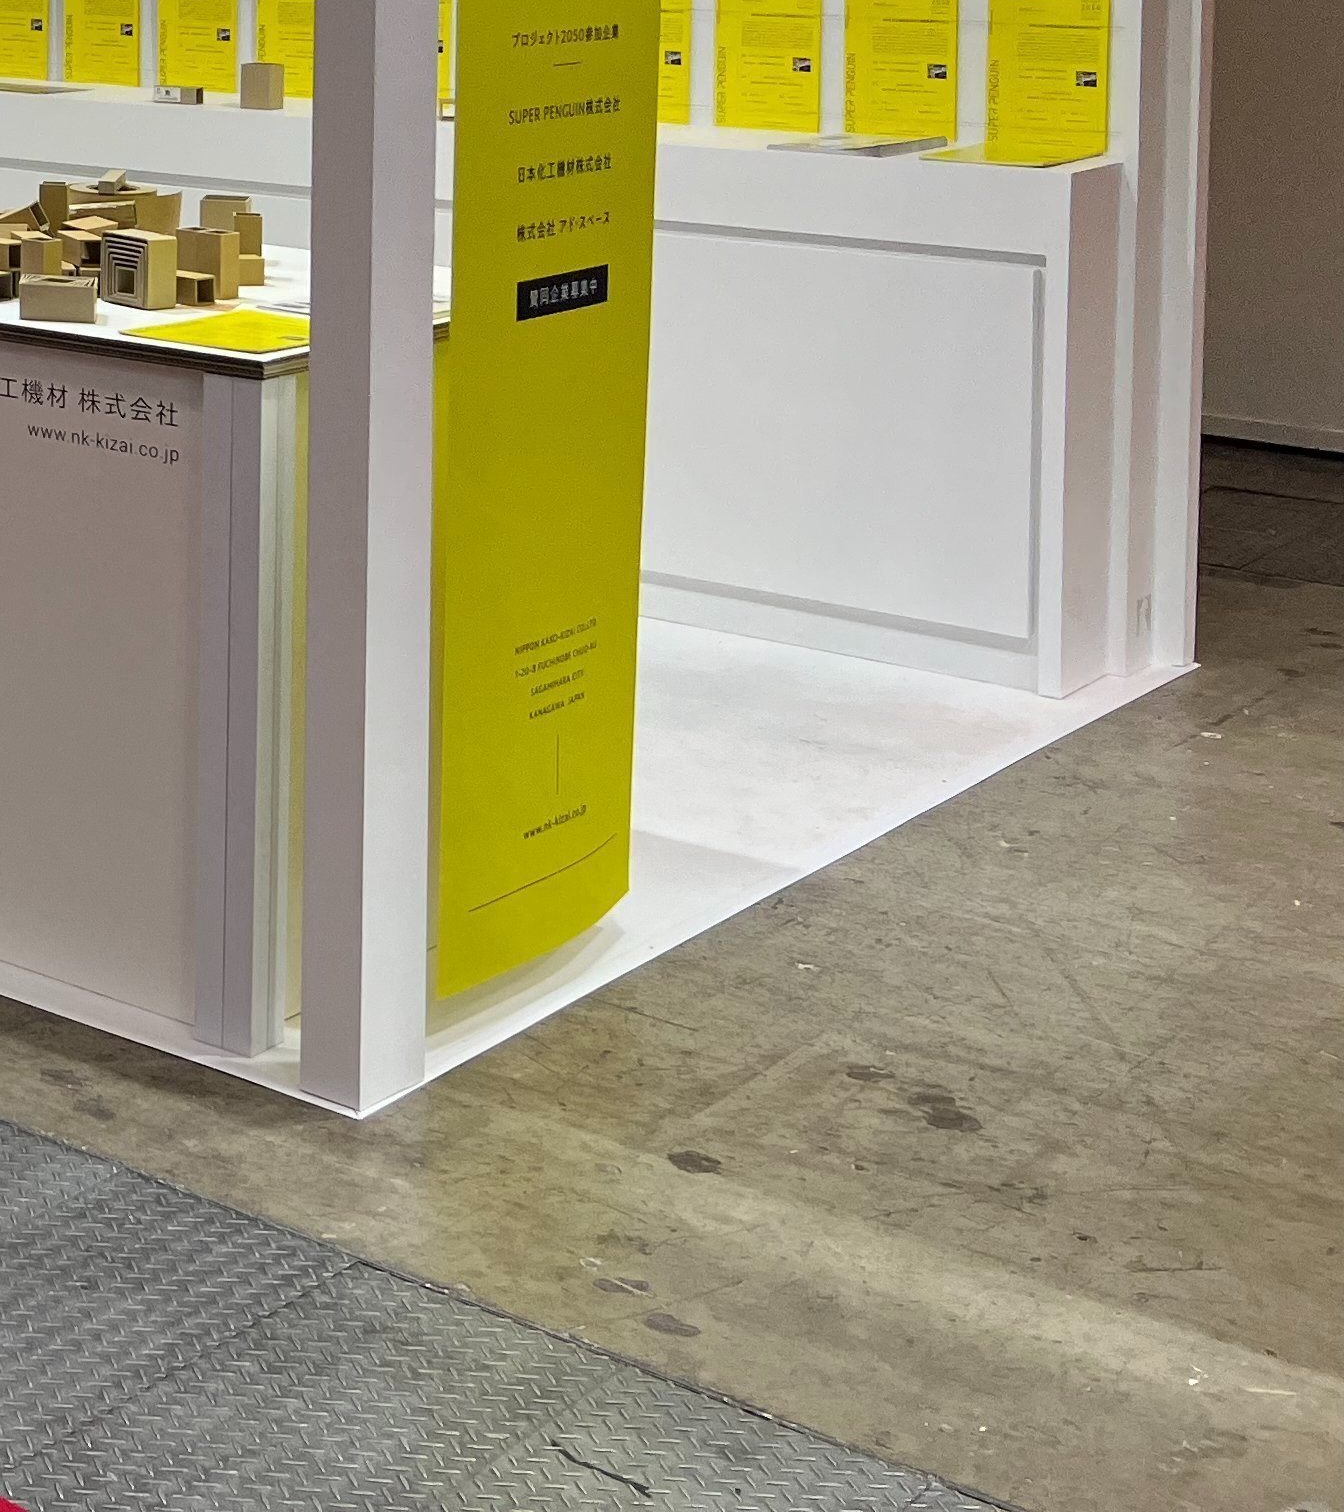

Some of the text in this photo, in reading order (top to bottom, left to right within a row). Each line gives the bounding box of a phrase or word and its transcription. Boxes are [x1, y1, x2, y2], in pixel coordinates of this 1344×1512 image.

[508, 107, 541, 126] SUPER
[517, 152, 612, 184] 日本化工機材株式会社
[517, 222, 556, 242] 株式会社
[78, 387, 180, 428] 株式会社
[27, 424, 180, 465] www.nk-kizai.co.jp
